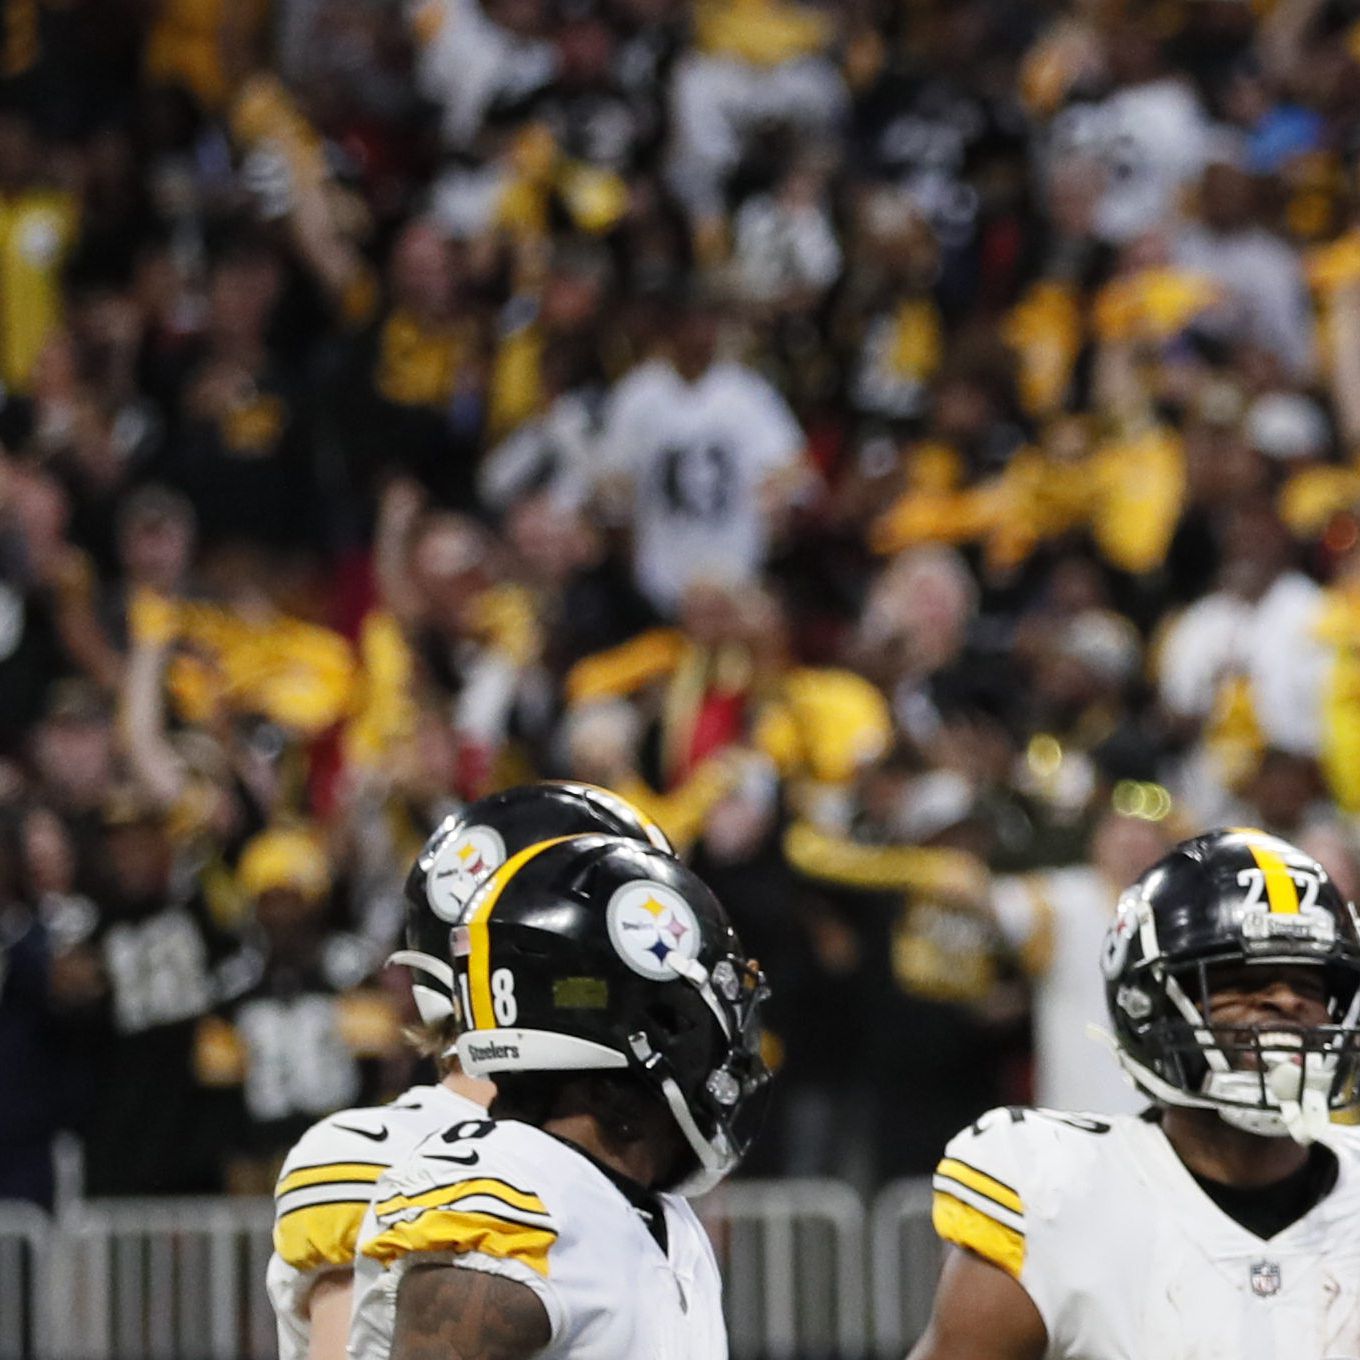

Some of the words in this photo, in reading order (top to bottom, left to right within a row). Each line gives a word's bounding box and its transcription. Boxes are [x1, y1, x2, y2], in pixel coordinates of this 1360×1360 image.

[1237, 867, 1321, 913] 22
[457, 967, 519, 1031] 18
[469, 1041, 520, 1062] Steelers
